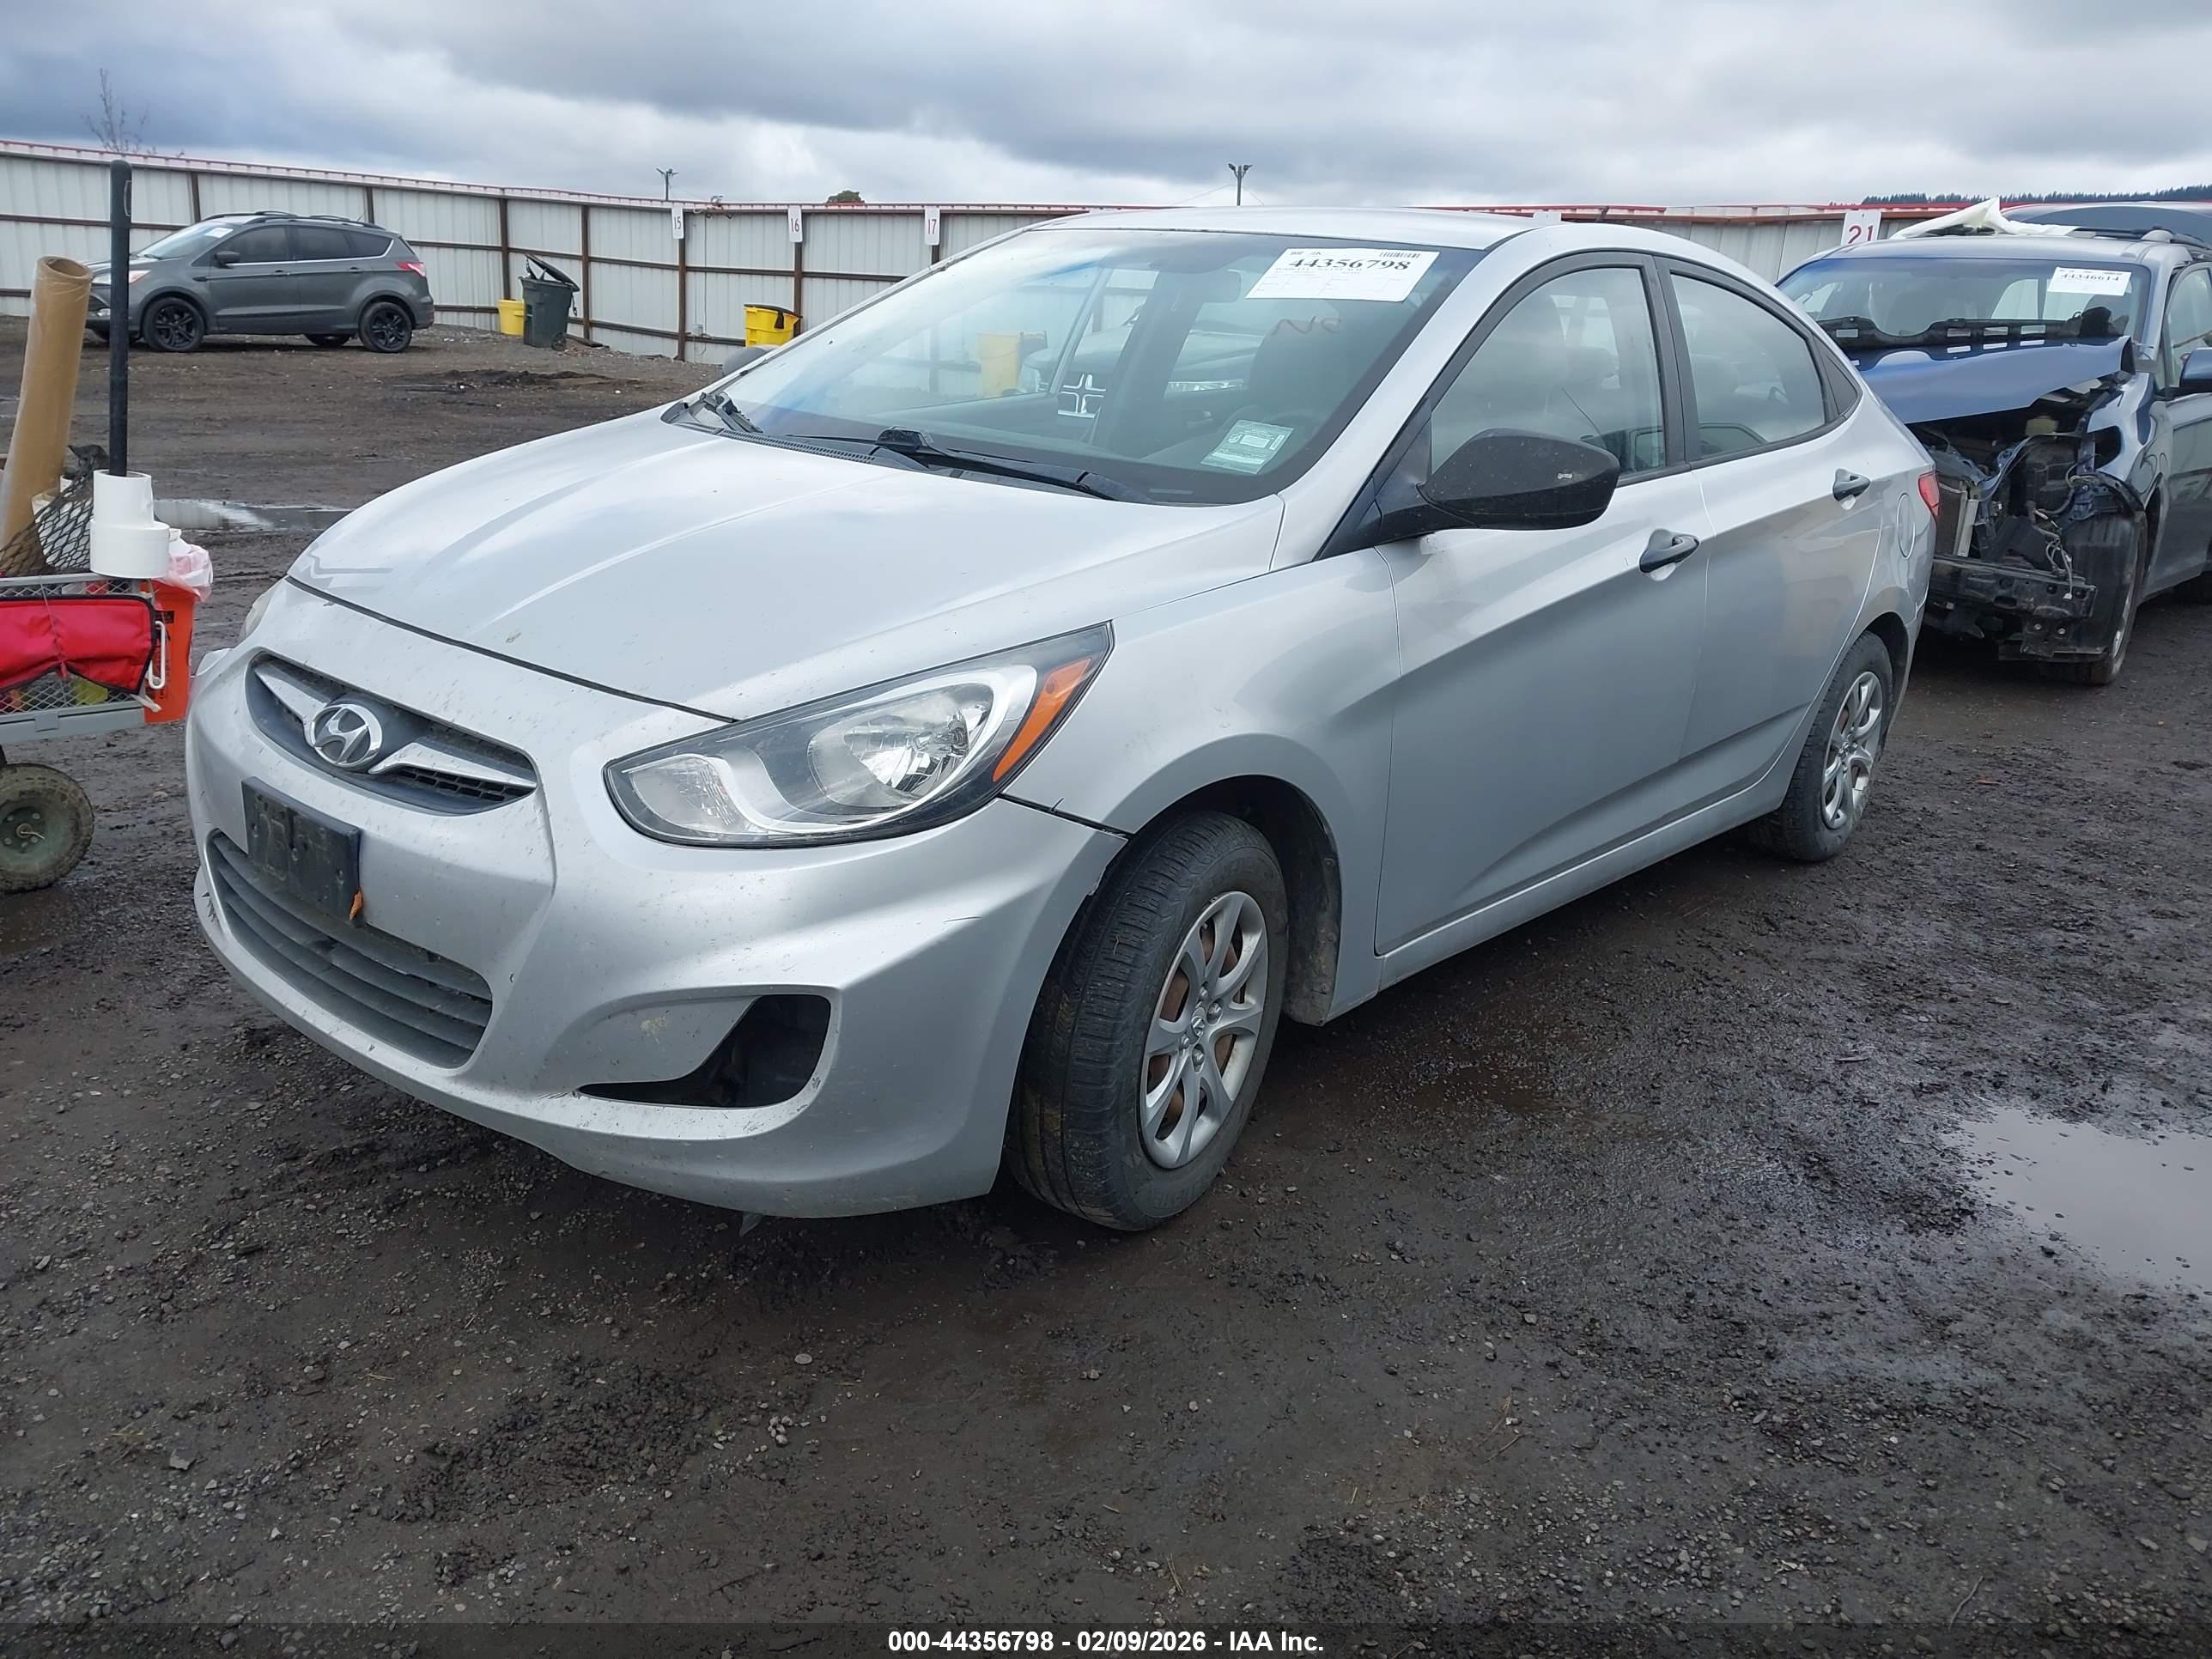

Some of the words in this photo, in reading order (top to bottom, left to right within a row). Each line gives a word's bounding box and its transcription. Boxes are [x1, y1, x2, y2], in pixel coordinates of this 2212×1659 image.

[674, 216, 682, 230] 15
[791, 218, 800, 233] 16
[927, 219, 937, 234] 17
[1848, 225, 1874, 244] 21
[1288, 258, 1411, 270] 44356798
